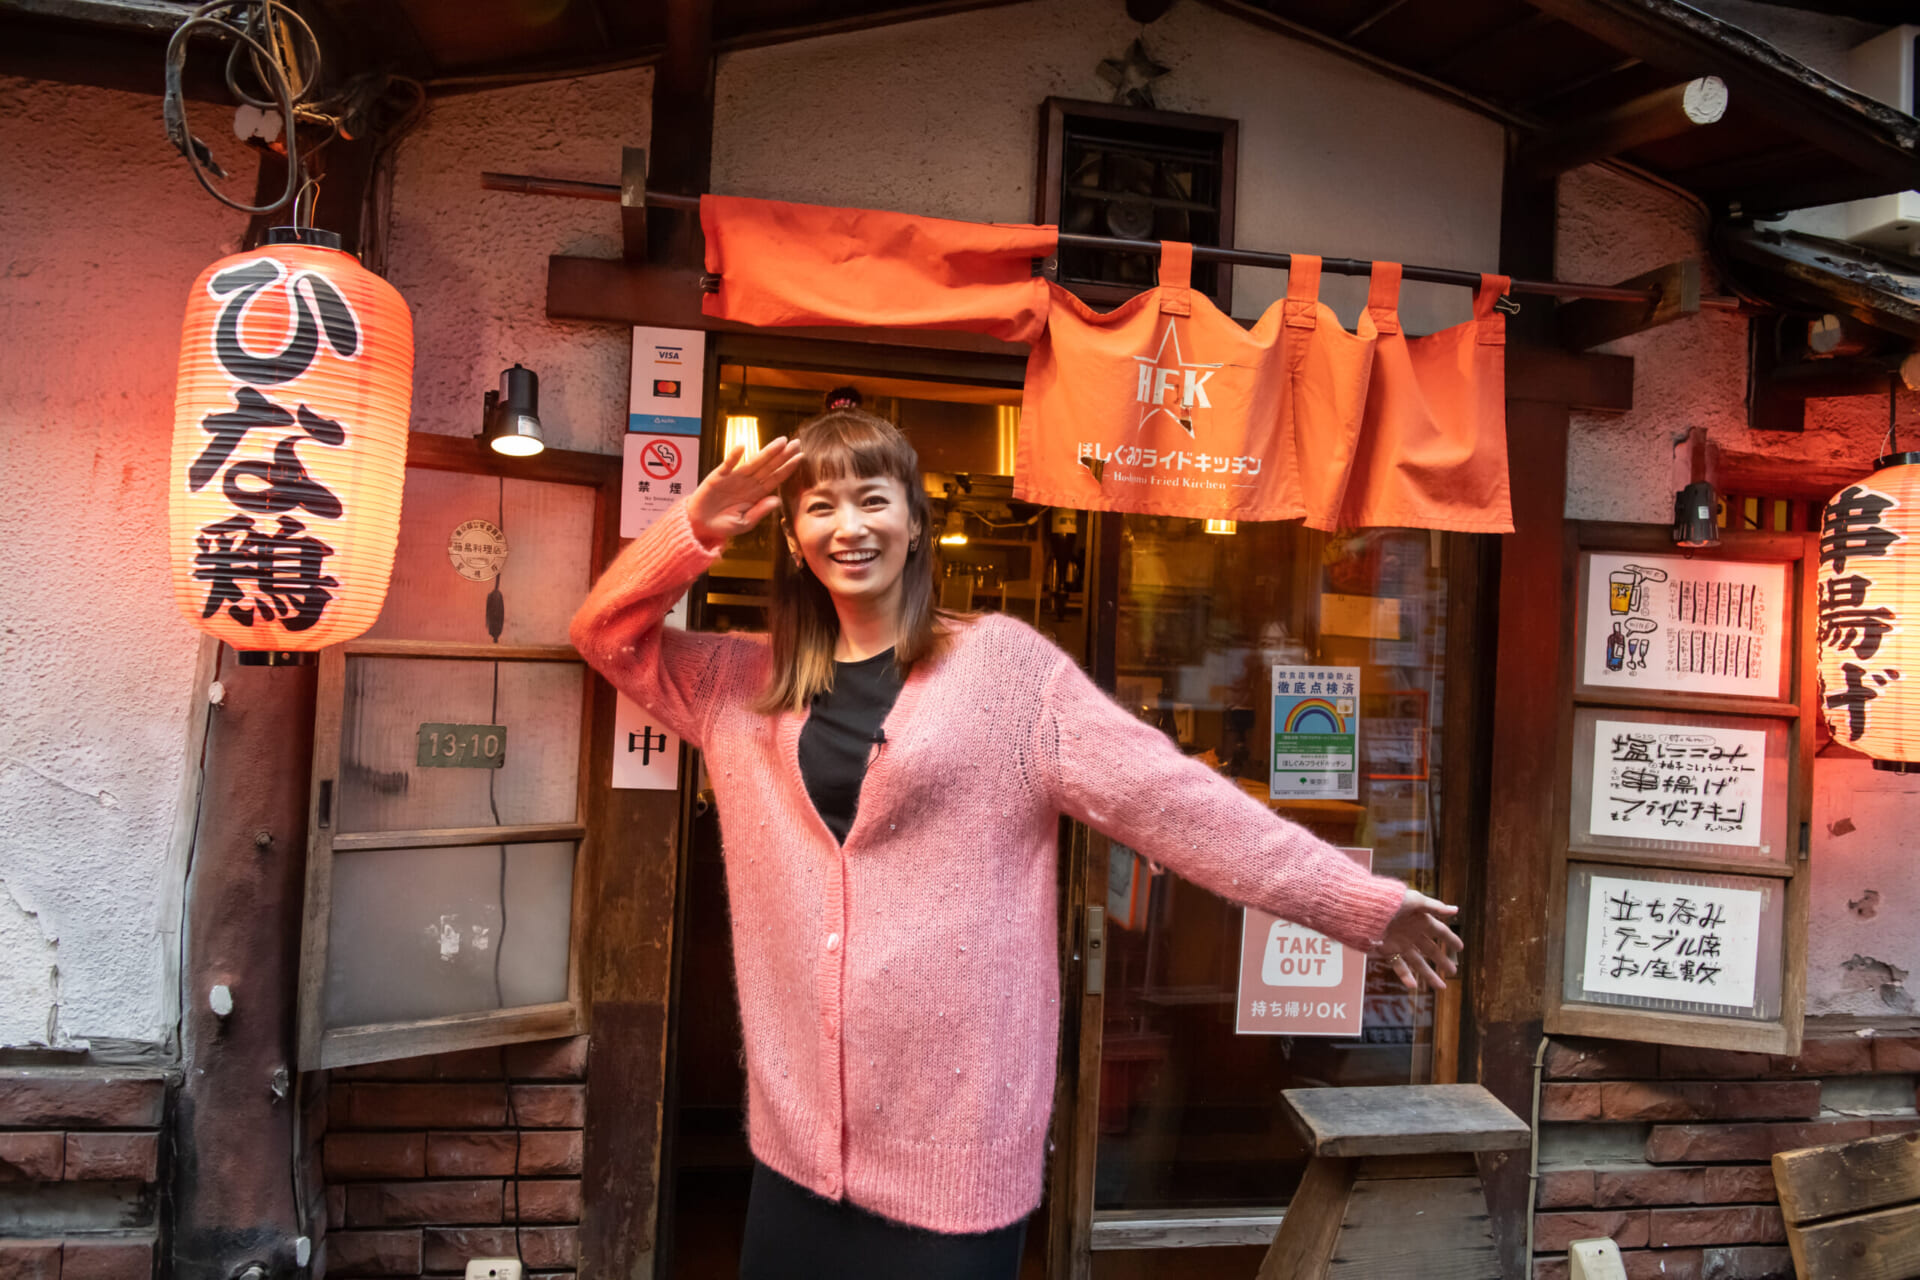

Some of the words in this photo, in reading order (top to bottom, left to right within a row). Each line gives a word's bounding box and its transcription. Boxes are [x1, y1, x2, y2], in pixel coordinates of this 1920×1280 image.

[659, 351, 679, 360] VISA
[1136, 363, 1215, 409] HFK
[189, 257, 358, 632] ひな鶏
[638, 481, 682, 494] 禁煙
[1150, 475, 1179, 487] Fried
[1182, 477, 1226, 490] Kitchen
[1278, 681, 1354, 695] 徹底点検済
[430, 732, 499, 758] 13-10
[1621, 768, 1739, 795] 串揚げ
[1610, 797, 1745, 823] フライドチキン
[1610, 889, 1726, 930] 立ち呑み
[1276, 936, 1332, 955] TAKE
[1614, 928, 1722, 958] テーブル席
[1280, 957, 1326, 977] OUT
[1610, 954, 1722, 986] お座敷
[1251, 1000, 1347, 1019] 持ち帰りOK
